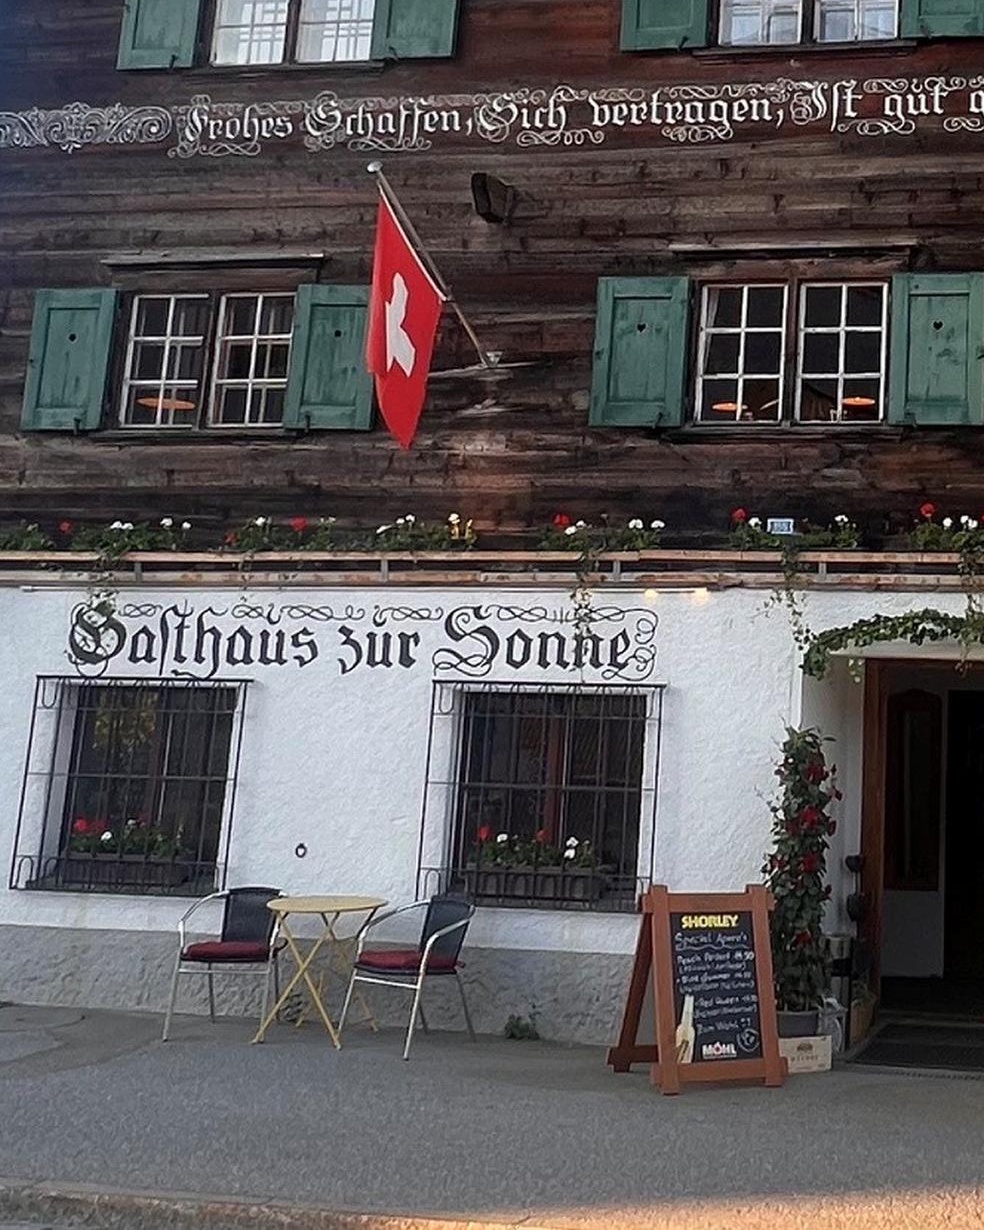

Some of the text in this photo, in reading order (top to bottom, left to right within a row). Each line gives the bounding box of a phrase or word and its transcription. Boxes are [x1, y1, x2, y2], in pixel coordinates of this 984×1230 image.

[66, 600, 645, 679] Gasthaus zur Sonne
[681, 914, 738, 929] SHORLEY
